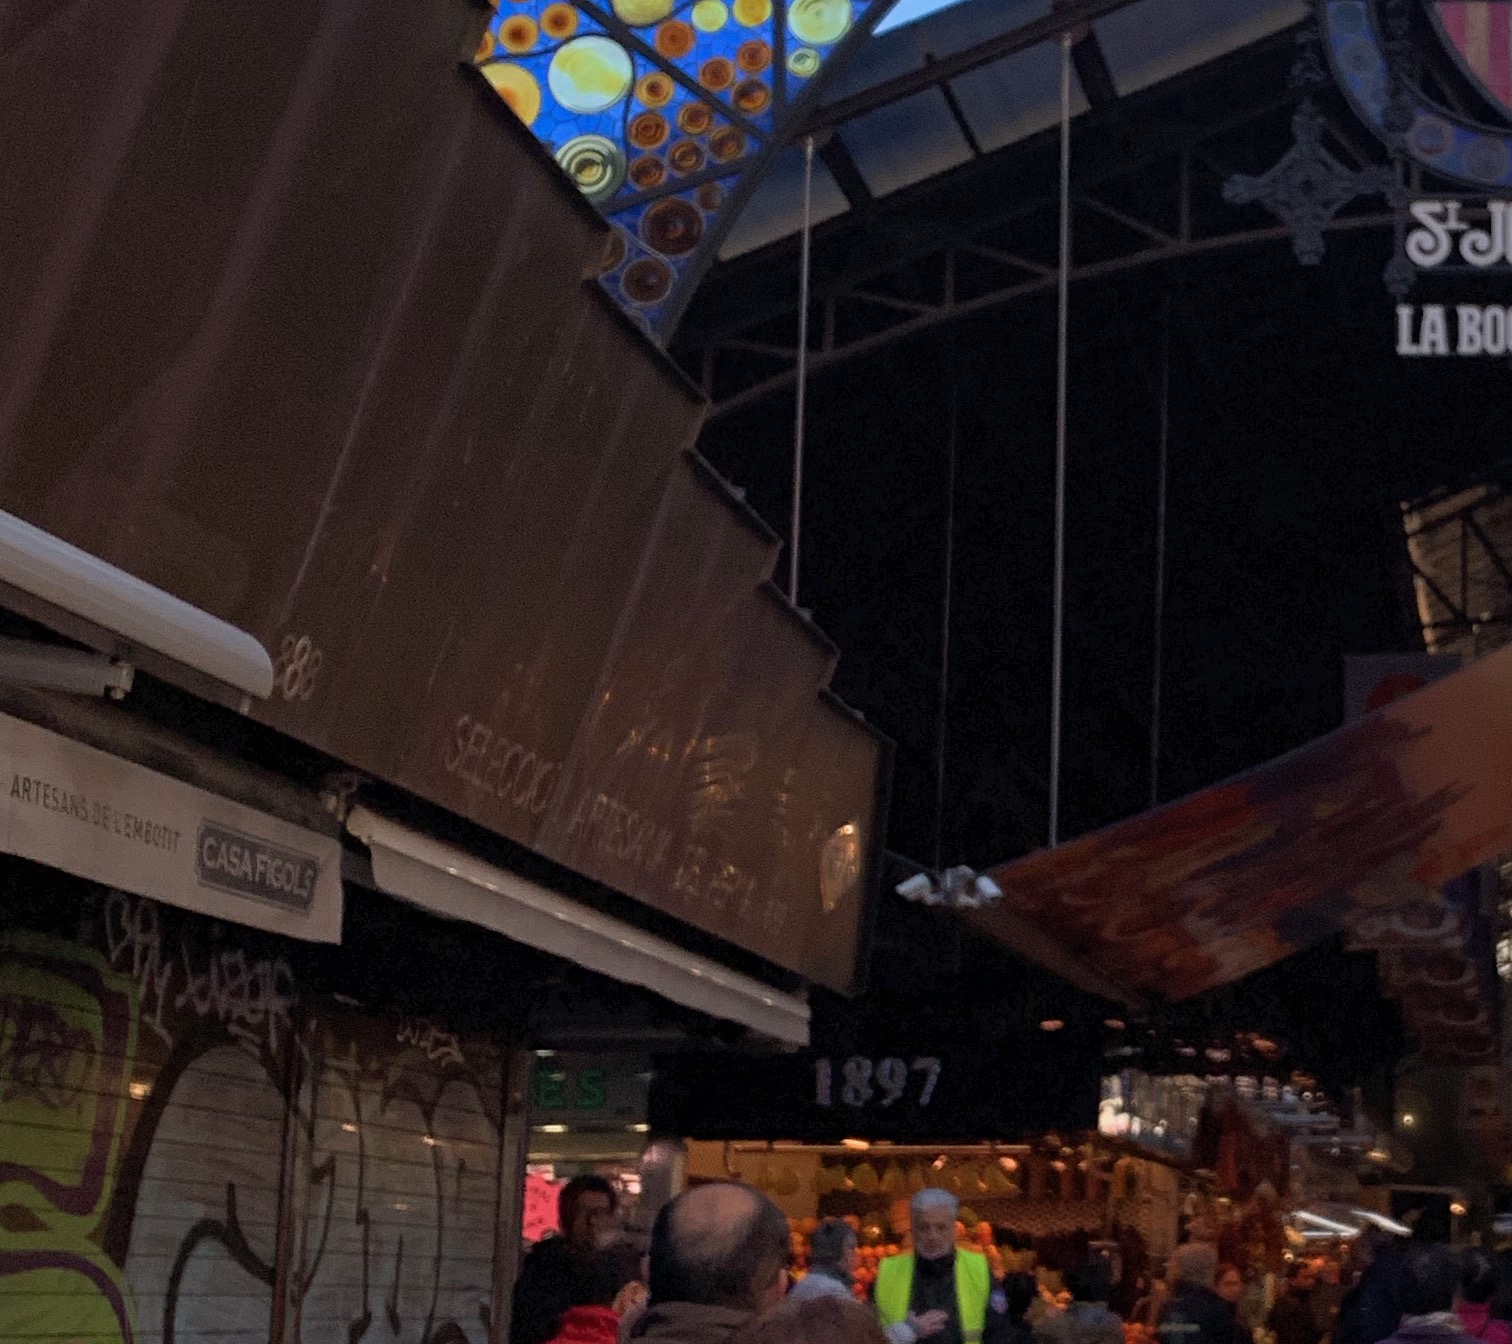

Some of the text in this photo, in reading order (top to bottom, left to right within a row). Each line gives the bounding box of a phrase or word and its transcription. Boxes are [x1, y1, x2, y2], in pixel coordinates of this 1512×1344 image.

[1395, 303, 1448, 356] LA
[10, 773, 89, 823] ARTESANS
[91, 803, 111, 833] DE
[202, 835, 254, 884] CASA
[813, 1056, 942, 1108] 1897
